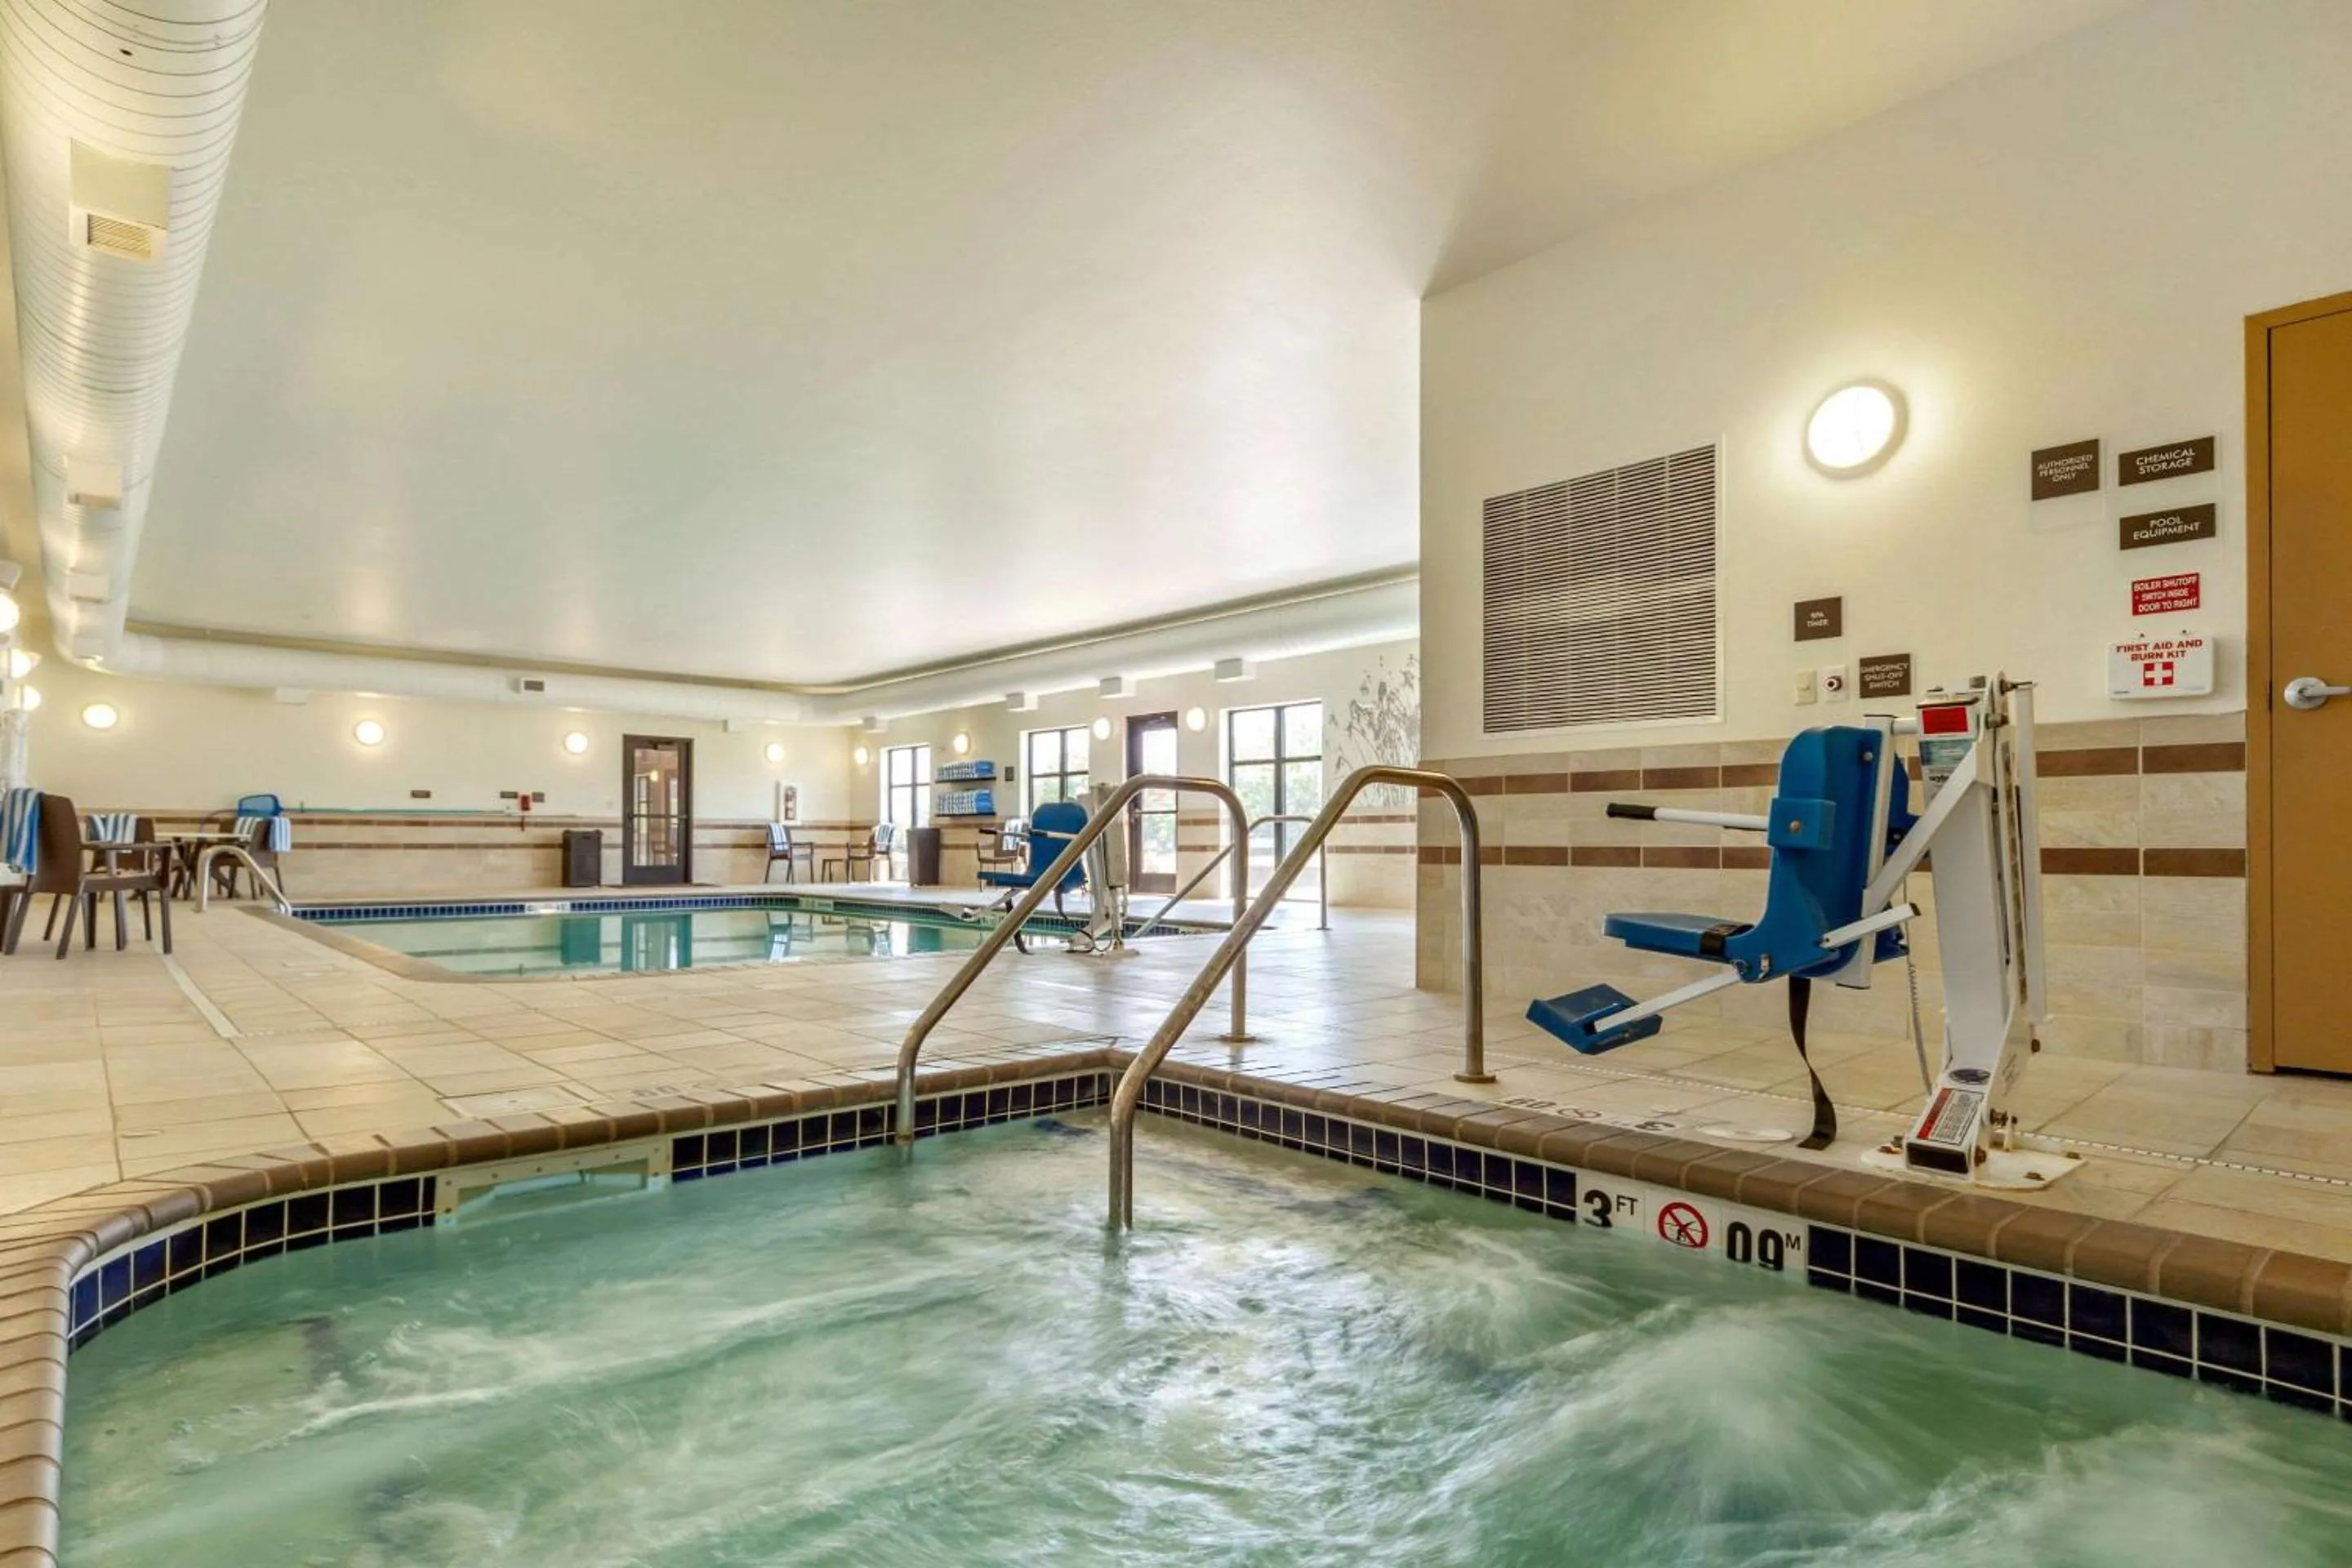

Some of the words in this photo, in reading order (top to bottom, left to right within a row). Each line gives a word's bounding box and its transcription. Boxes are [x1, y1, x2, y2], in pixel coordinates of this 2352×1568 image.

[2038, 454, 2093, 470] AUTHORIZED
[2136, 448, 2196, 466] CHEMICAL
[2139, 457, 2193, 474] STORAGE
[2052, 472, 2077, 482] ONLY
[2149, 516, 2184, 528] POOL
[2132, 522, 2201, 540] EQUIPMENT
[2133, 581, 2161, 592] BOILER
[2162, 575, 2197, 589] SHUTOFF
[2138, 602, 2161, 612] DOOR
[2162, 601, 2172, 609] TO
[2173, 597, 2197, 608] RIGHT
[2116, 644, 2149, 653] FIRST
[2153, 641, 2172, 650] AID
[2176, 639, 2203, 648] AND
[2131, 652, 2163, 662] BURN
[2167, 650, 2185, 658] KIT
[1616, 1195, 1638, 1215] FT
[1785, 1234, 1802, 1250] M
